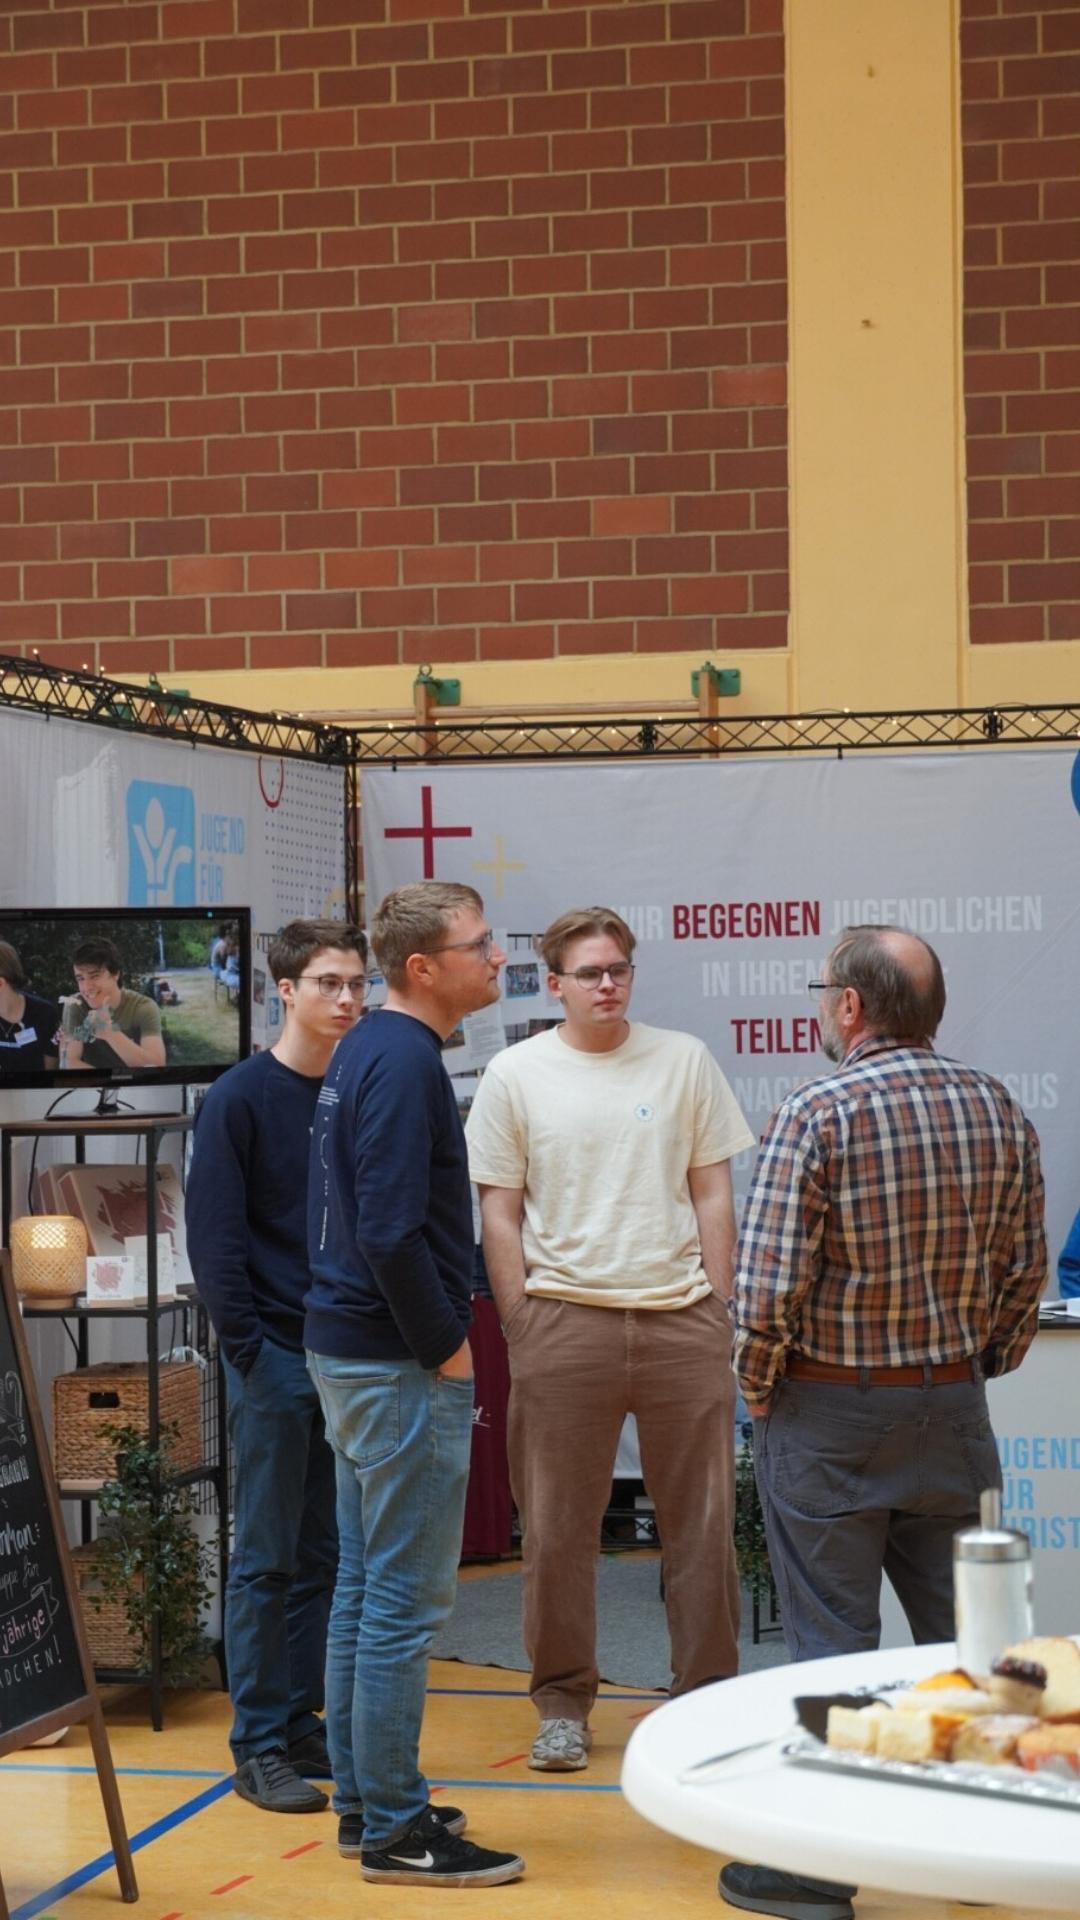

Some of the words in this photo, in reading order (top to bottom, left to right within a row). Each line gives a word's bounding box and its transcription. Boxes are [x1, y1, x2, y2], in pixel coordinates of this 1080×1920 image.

[201, 815, 245, 855] JUGEND
[201, 856, 224, 902] FÜR
[673, 901, 820, 940] BEGEGNEN
[831, 895, 1042, 936] JUGENDLICHEN
[702, 961, 730, 998] IN
[2, 1609, 46, 1654] jährige
